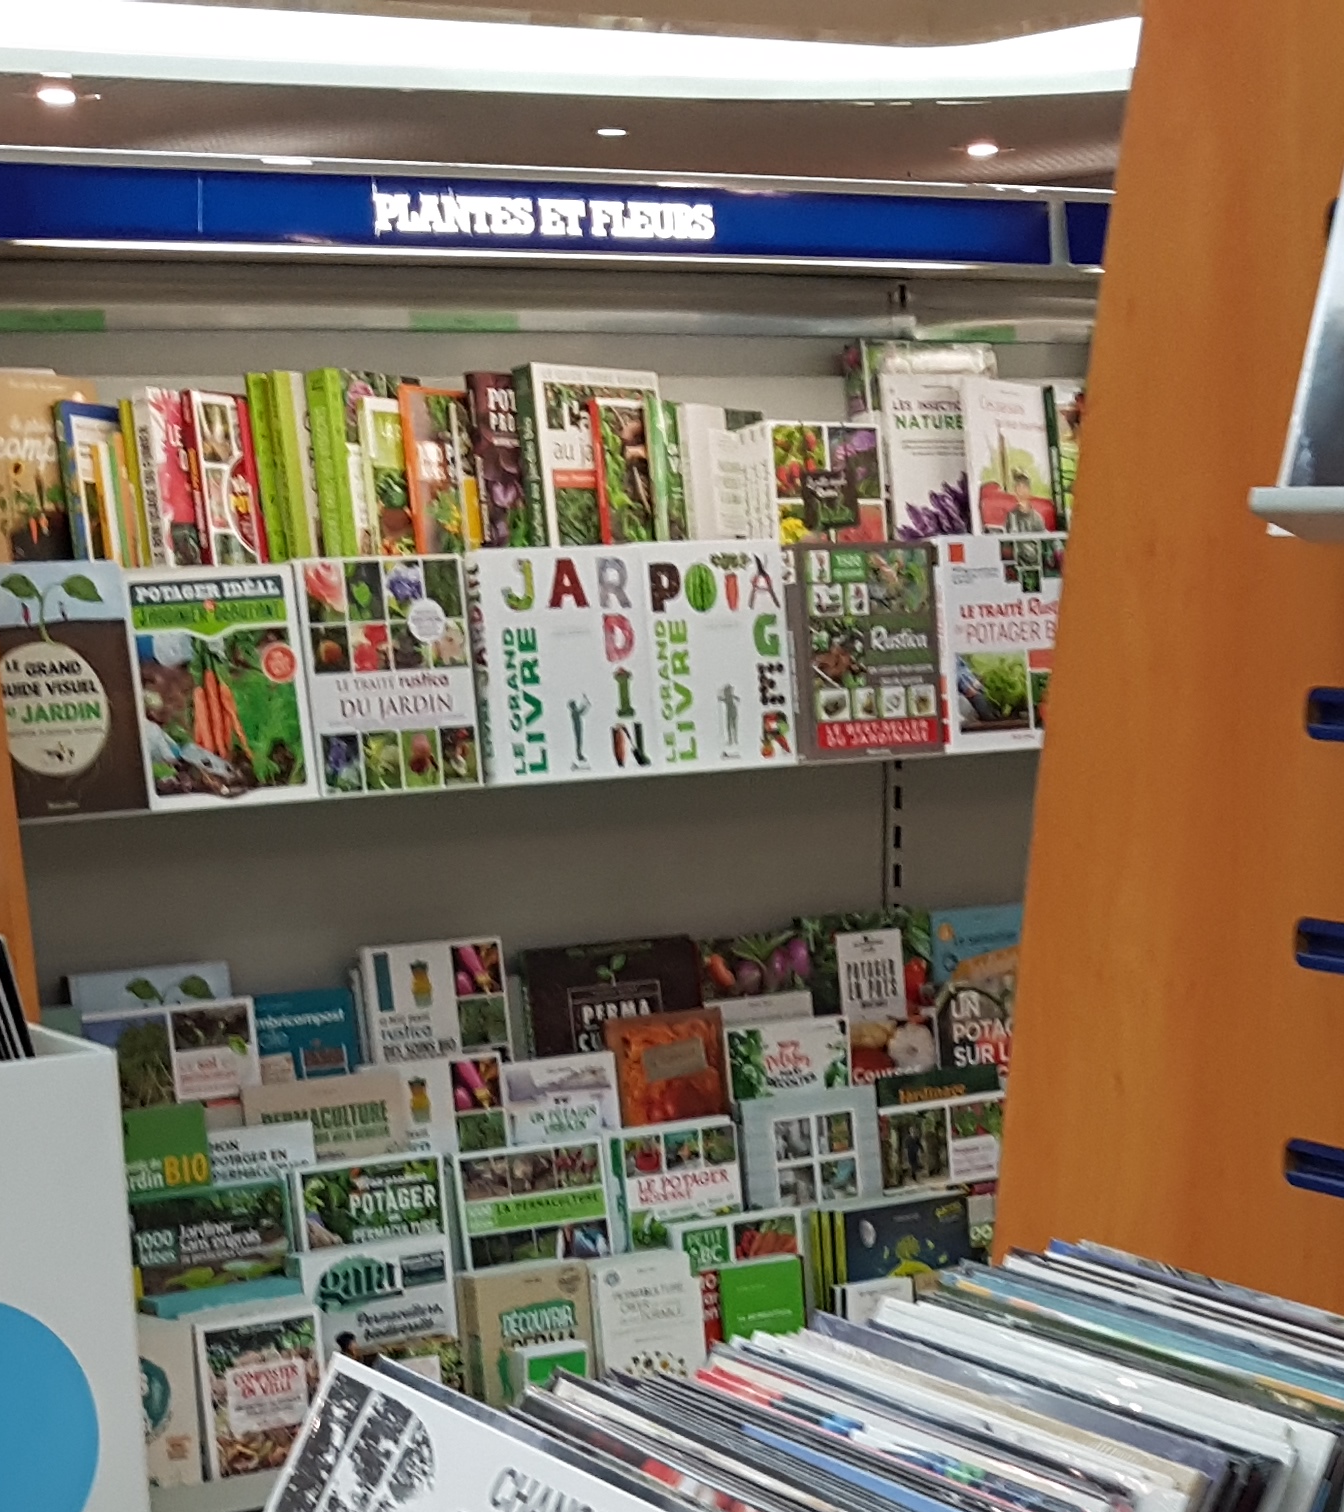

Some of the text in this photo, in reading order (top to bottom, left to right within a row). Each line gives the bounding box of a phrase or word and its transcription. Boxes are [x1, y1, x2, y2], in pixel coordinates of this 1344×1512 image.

[373, 190, 715, 240] PLANTES ET FLEURS
[960, 604, 975, 619] LE
[967, 619, 1042, 644] POTAGER
[25, 660, 82, 678] GRAND
[46, 679, 99, 697] VISUEL
[518, 626, 550, 774] LIVRE
[669, 618, 699, 762] LIVRE
[21, 701, 102, 724] JARDIN
[340, 693, 454, 720] DU JARDIN
[951, 990, 983, 1019] UN
[954, 1042, 995, 1068] SUR
[163, 1152, 208, 1187] BIO
[349, 1183, 438, 1217] POTAGER
